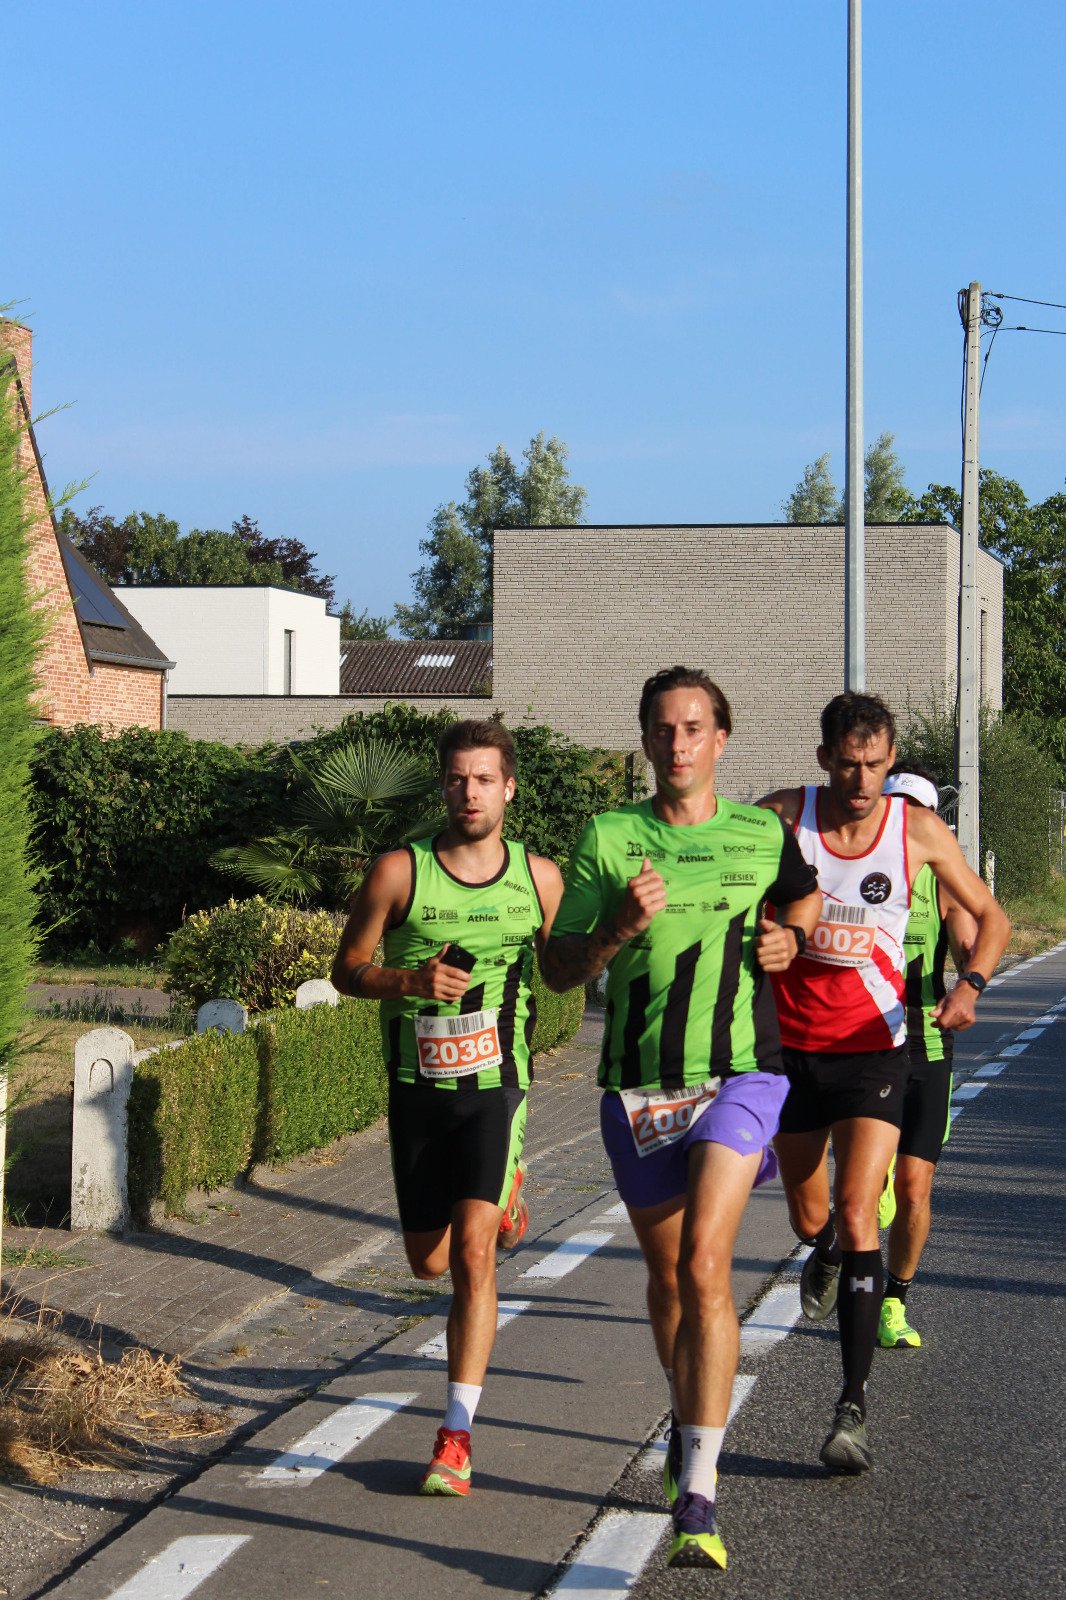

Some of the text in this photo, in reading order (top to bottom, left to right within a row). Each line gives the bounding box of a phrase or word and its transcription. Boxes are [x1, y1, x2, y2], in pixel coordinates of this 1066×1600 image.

[677, 854, 715, 864] Athlex
[467, 914, 500, 923] Athlex
[806, 926, 870, 955] 002
[422, 1033, 495, 1065] 2036
